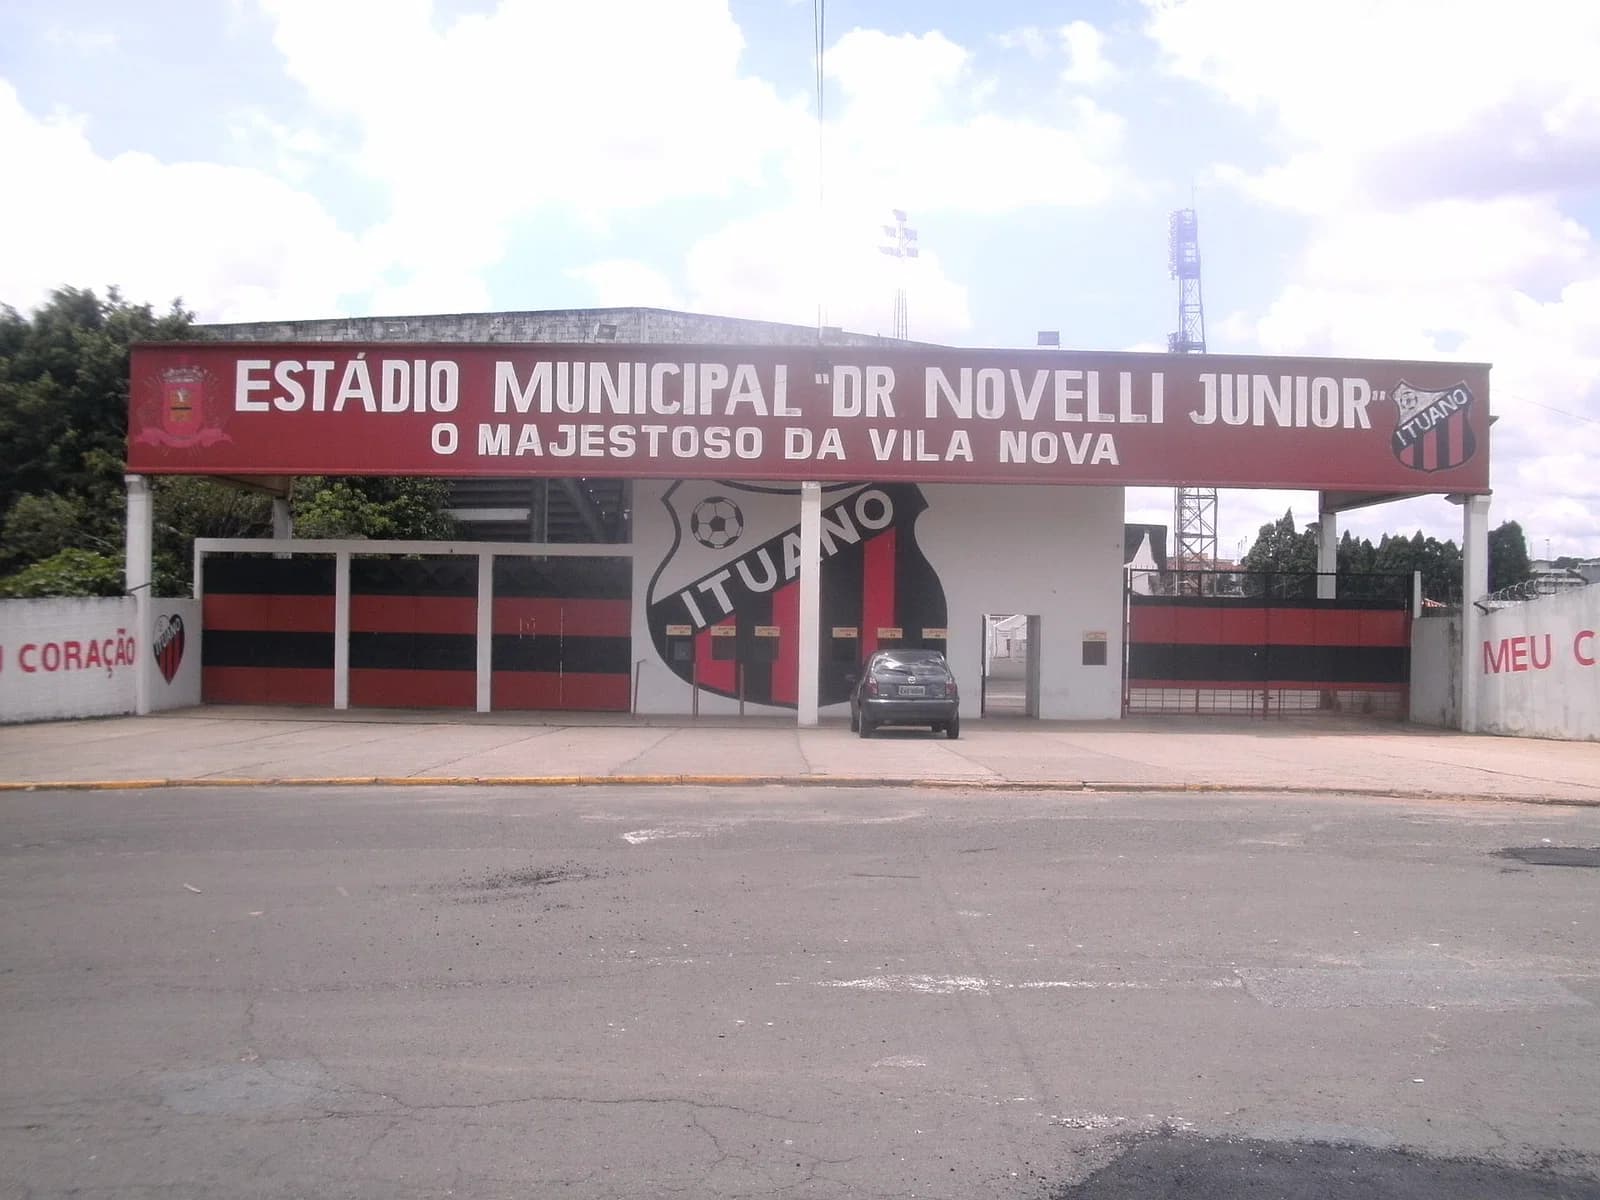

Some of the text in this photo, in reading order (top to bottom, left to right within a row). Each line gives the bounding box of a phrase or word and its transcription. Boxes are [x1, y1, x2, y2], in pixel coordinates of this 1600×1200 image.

[235, 352, 459, 412] ESTÁDIO
[494, 361, 803, 417] MUNICIPAL
[925, 367, 1165, 423] NOVELLI
[431, 422, 1120, 465] O MAJESTOSO DA VILA NOVA
[1396, 389, 1468, 446] ITUANO
[681, 489, 894, 629] ITUANO
[19, 627, 135, 679] CORAÇÃO
[1484, 634, 1552, 675] MEU
